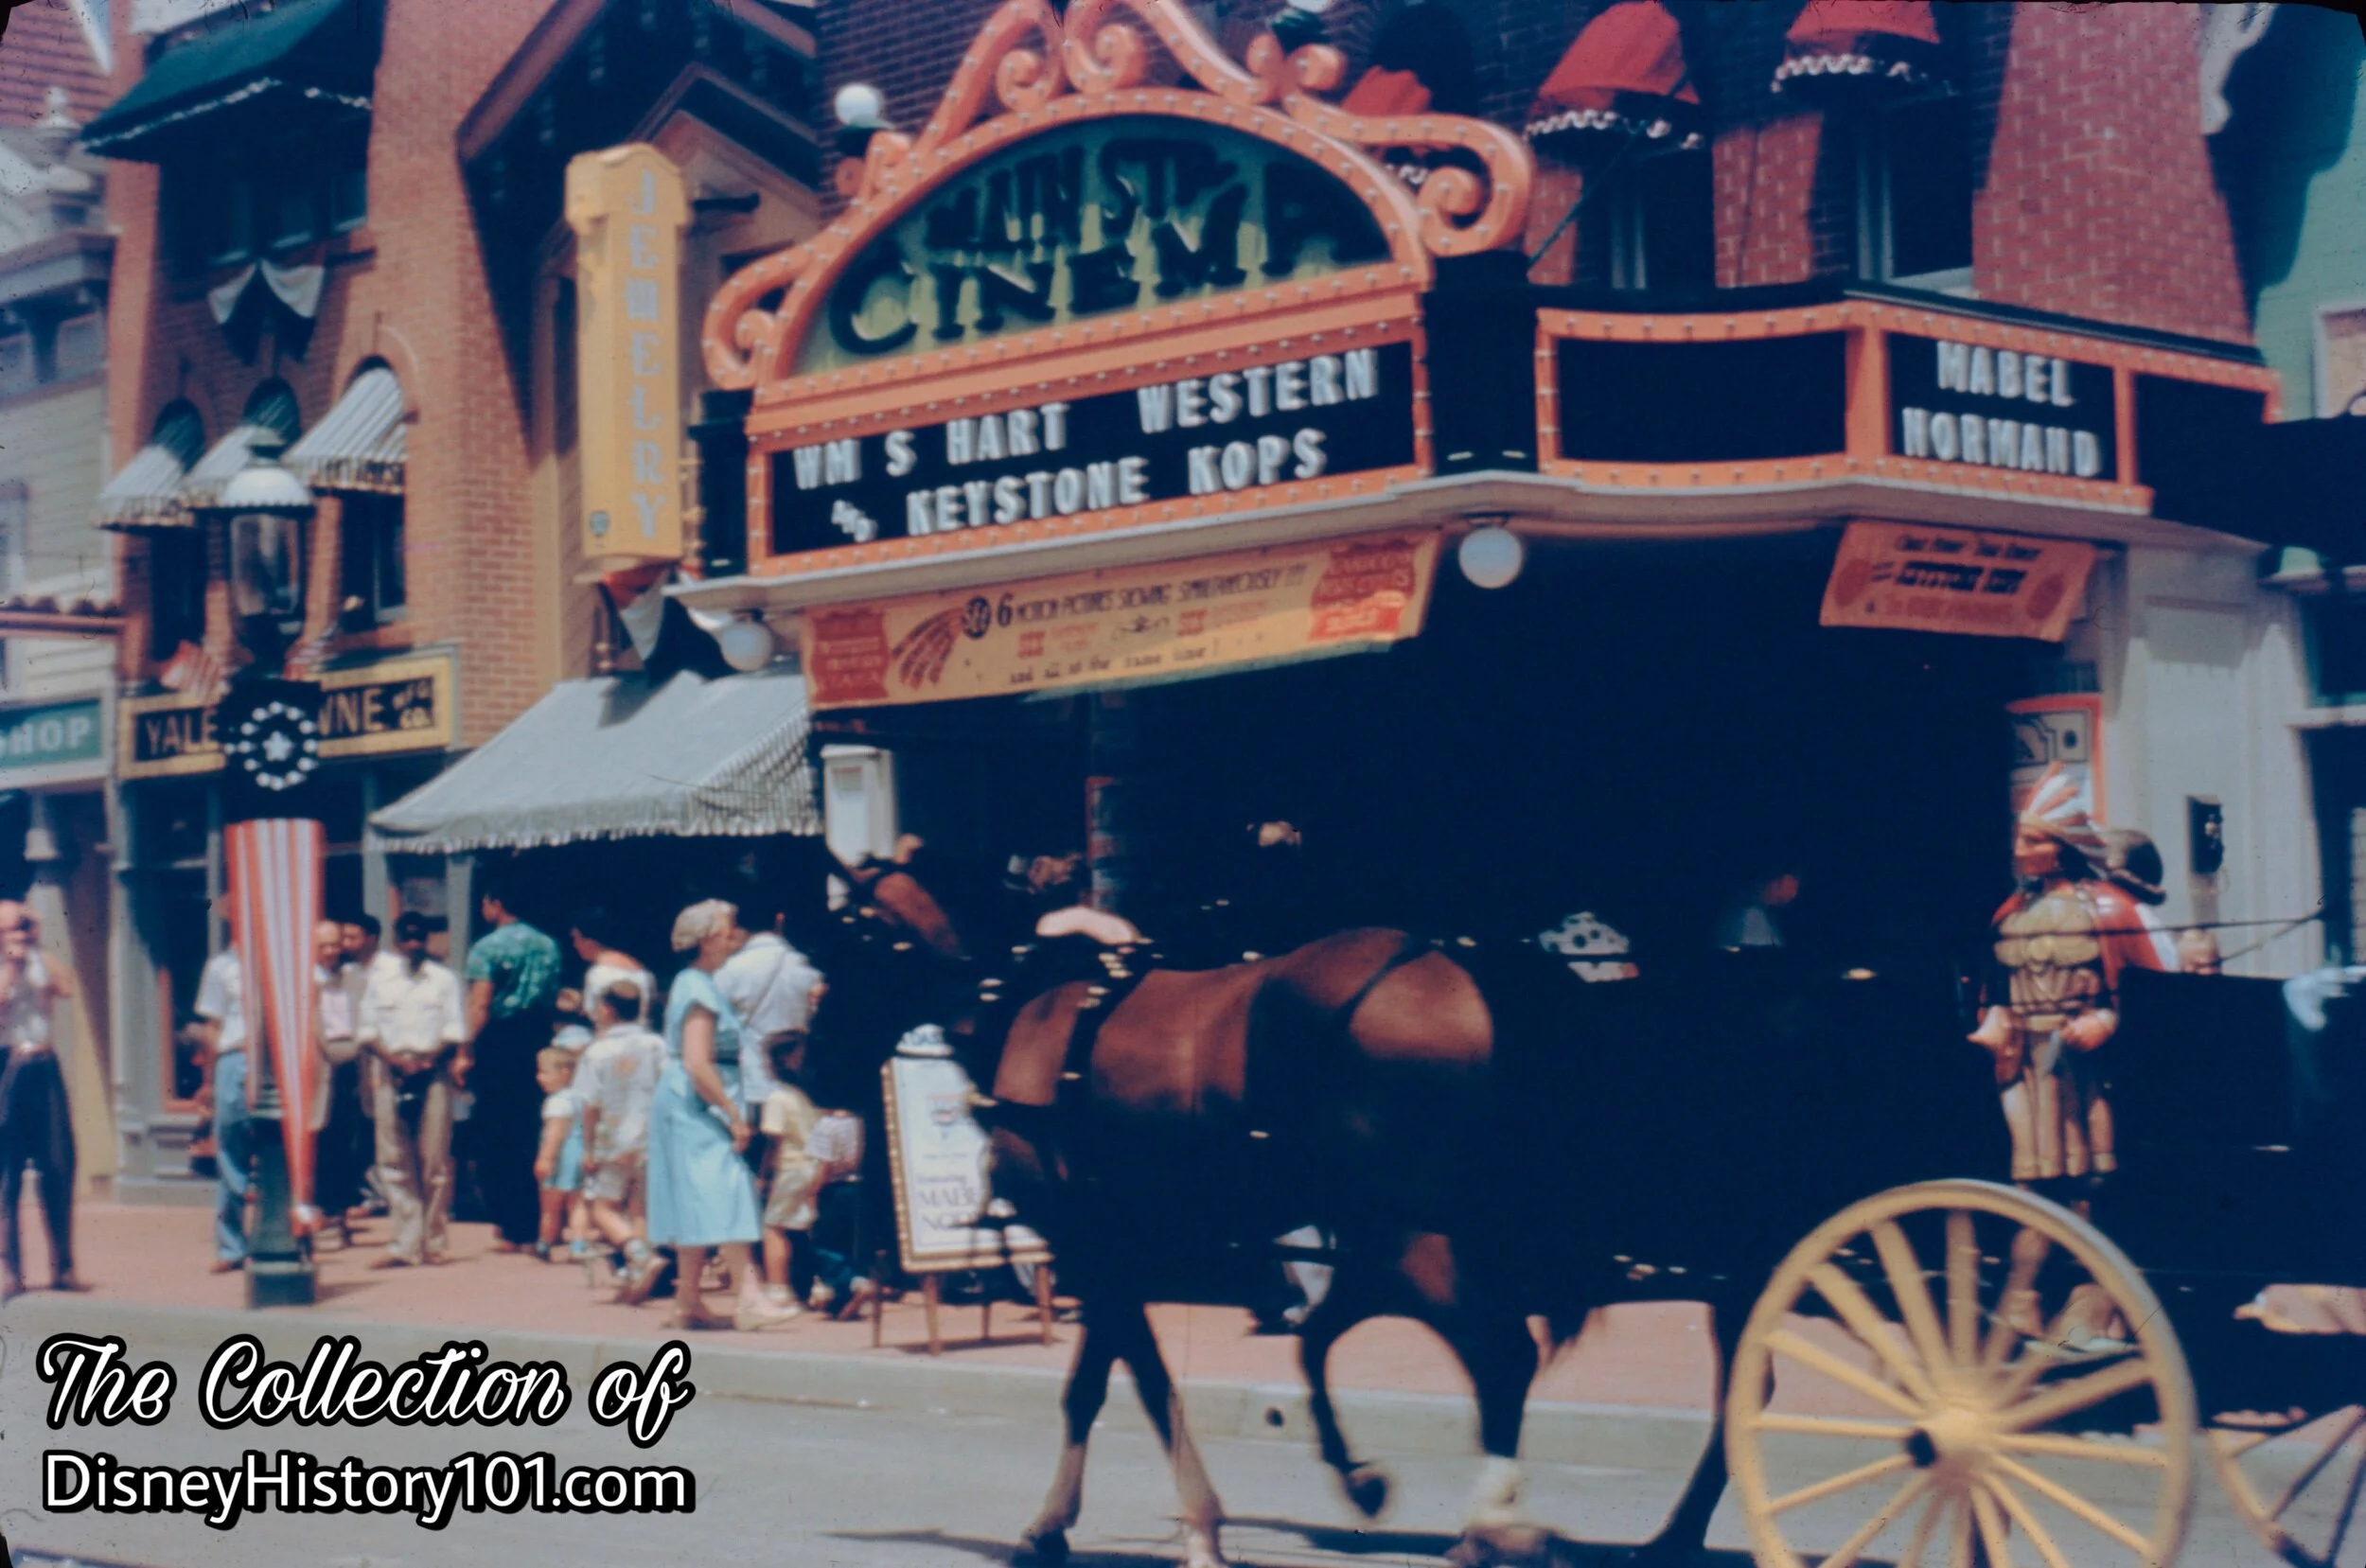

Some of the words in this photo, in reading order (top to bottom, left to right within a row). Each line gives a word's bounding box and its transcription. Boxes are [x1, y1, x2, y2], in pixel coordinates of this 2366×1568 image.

[926, 144, 1085, 252] MAIN
[827, 161, 1394, 356] CINEMA
[624, 167, 665, 539] JEWELRY
[1936, 340, 2076, 408] MABEL
[794, 438, 862, 490] WM
[885, 429, 916, 478] S
[946, 402, 1070, 466] HART
[1139, 347, 1380, 434] WESTERN
[1901, 407, 2103, 478] NORMAND
[907, 456, 1150, 537] KEYSTONE
[1189, 429, 1328, 496] KOPS
[997, 591, 1015, 628] 6
[144, 711, 218, 756] YALE
